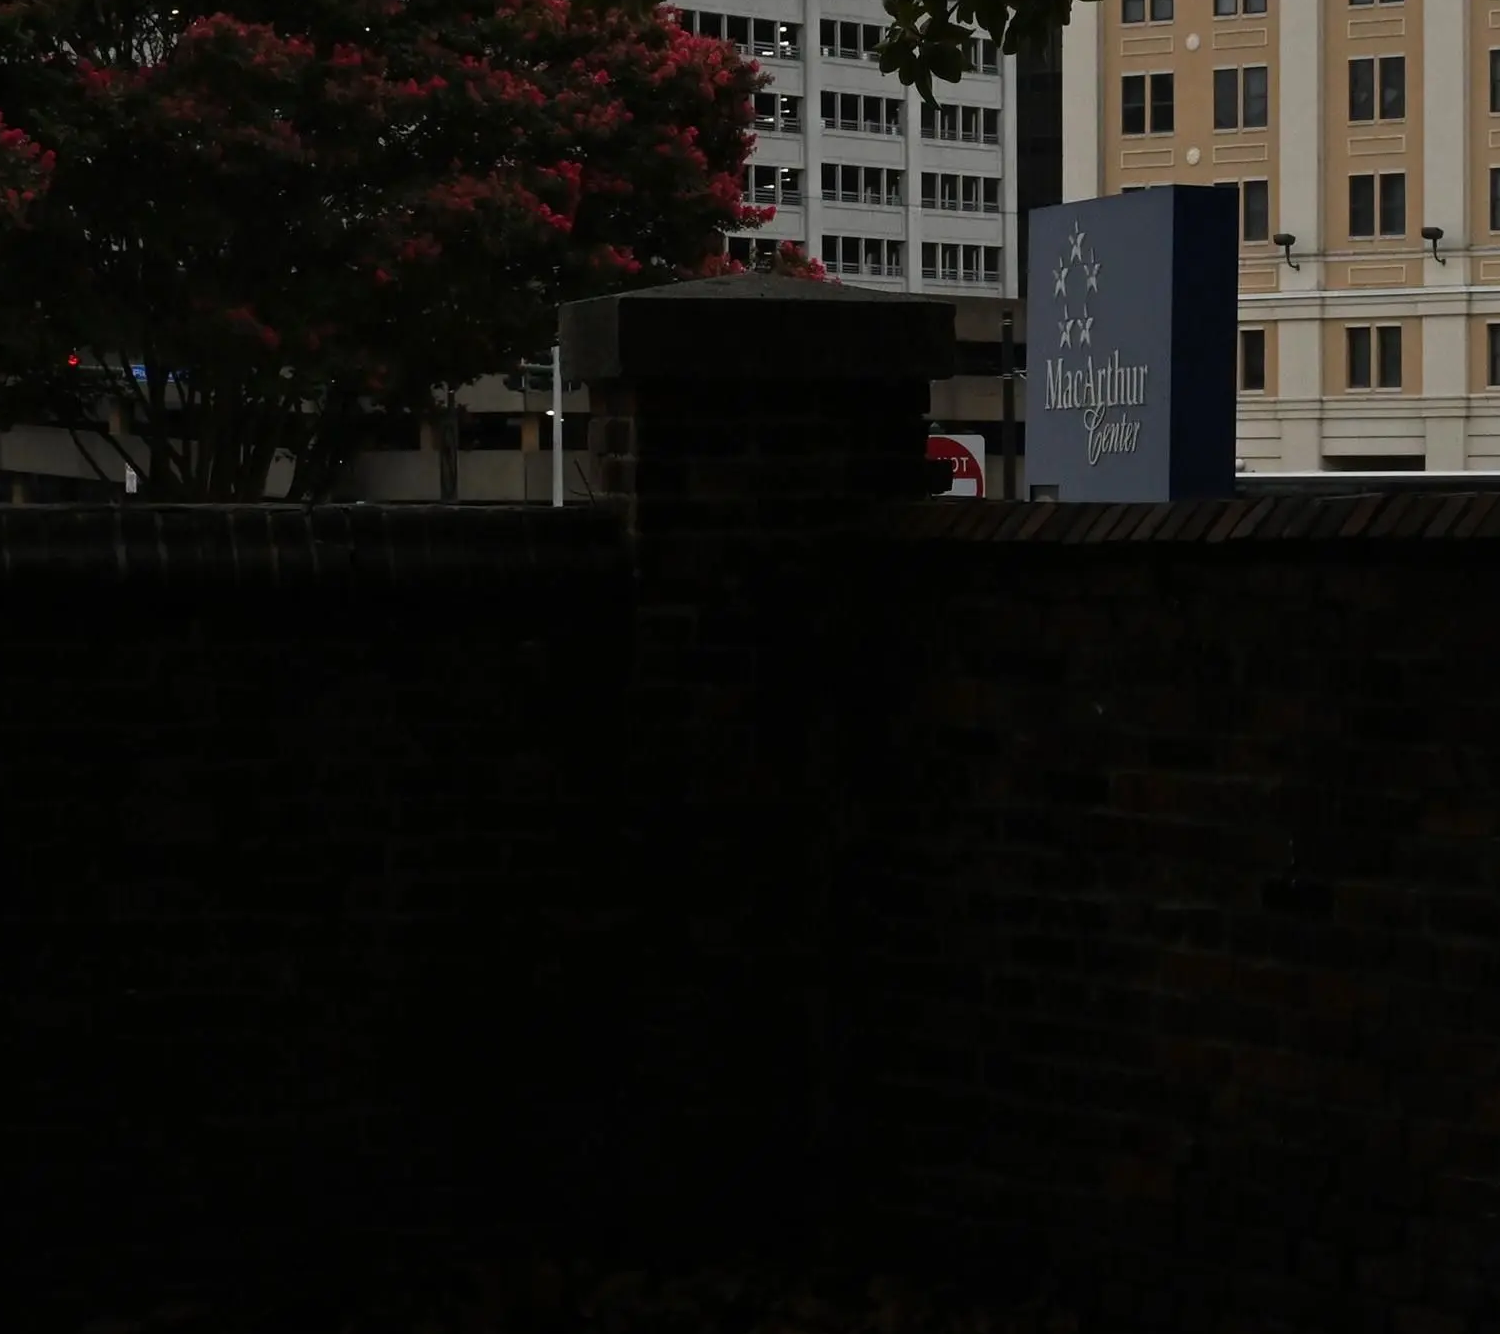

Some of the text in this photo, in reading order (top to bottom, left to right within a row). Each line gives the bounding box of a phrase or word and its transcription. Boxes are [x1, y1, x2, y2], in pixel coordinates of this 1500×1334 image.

[1045, 349, 1148, 410] MacArthur
[937, 457, 969, 473] OT
[1084, 405, 1141, 465] Center
